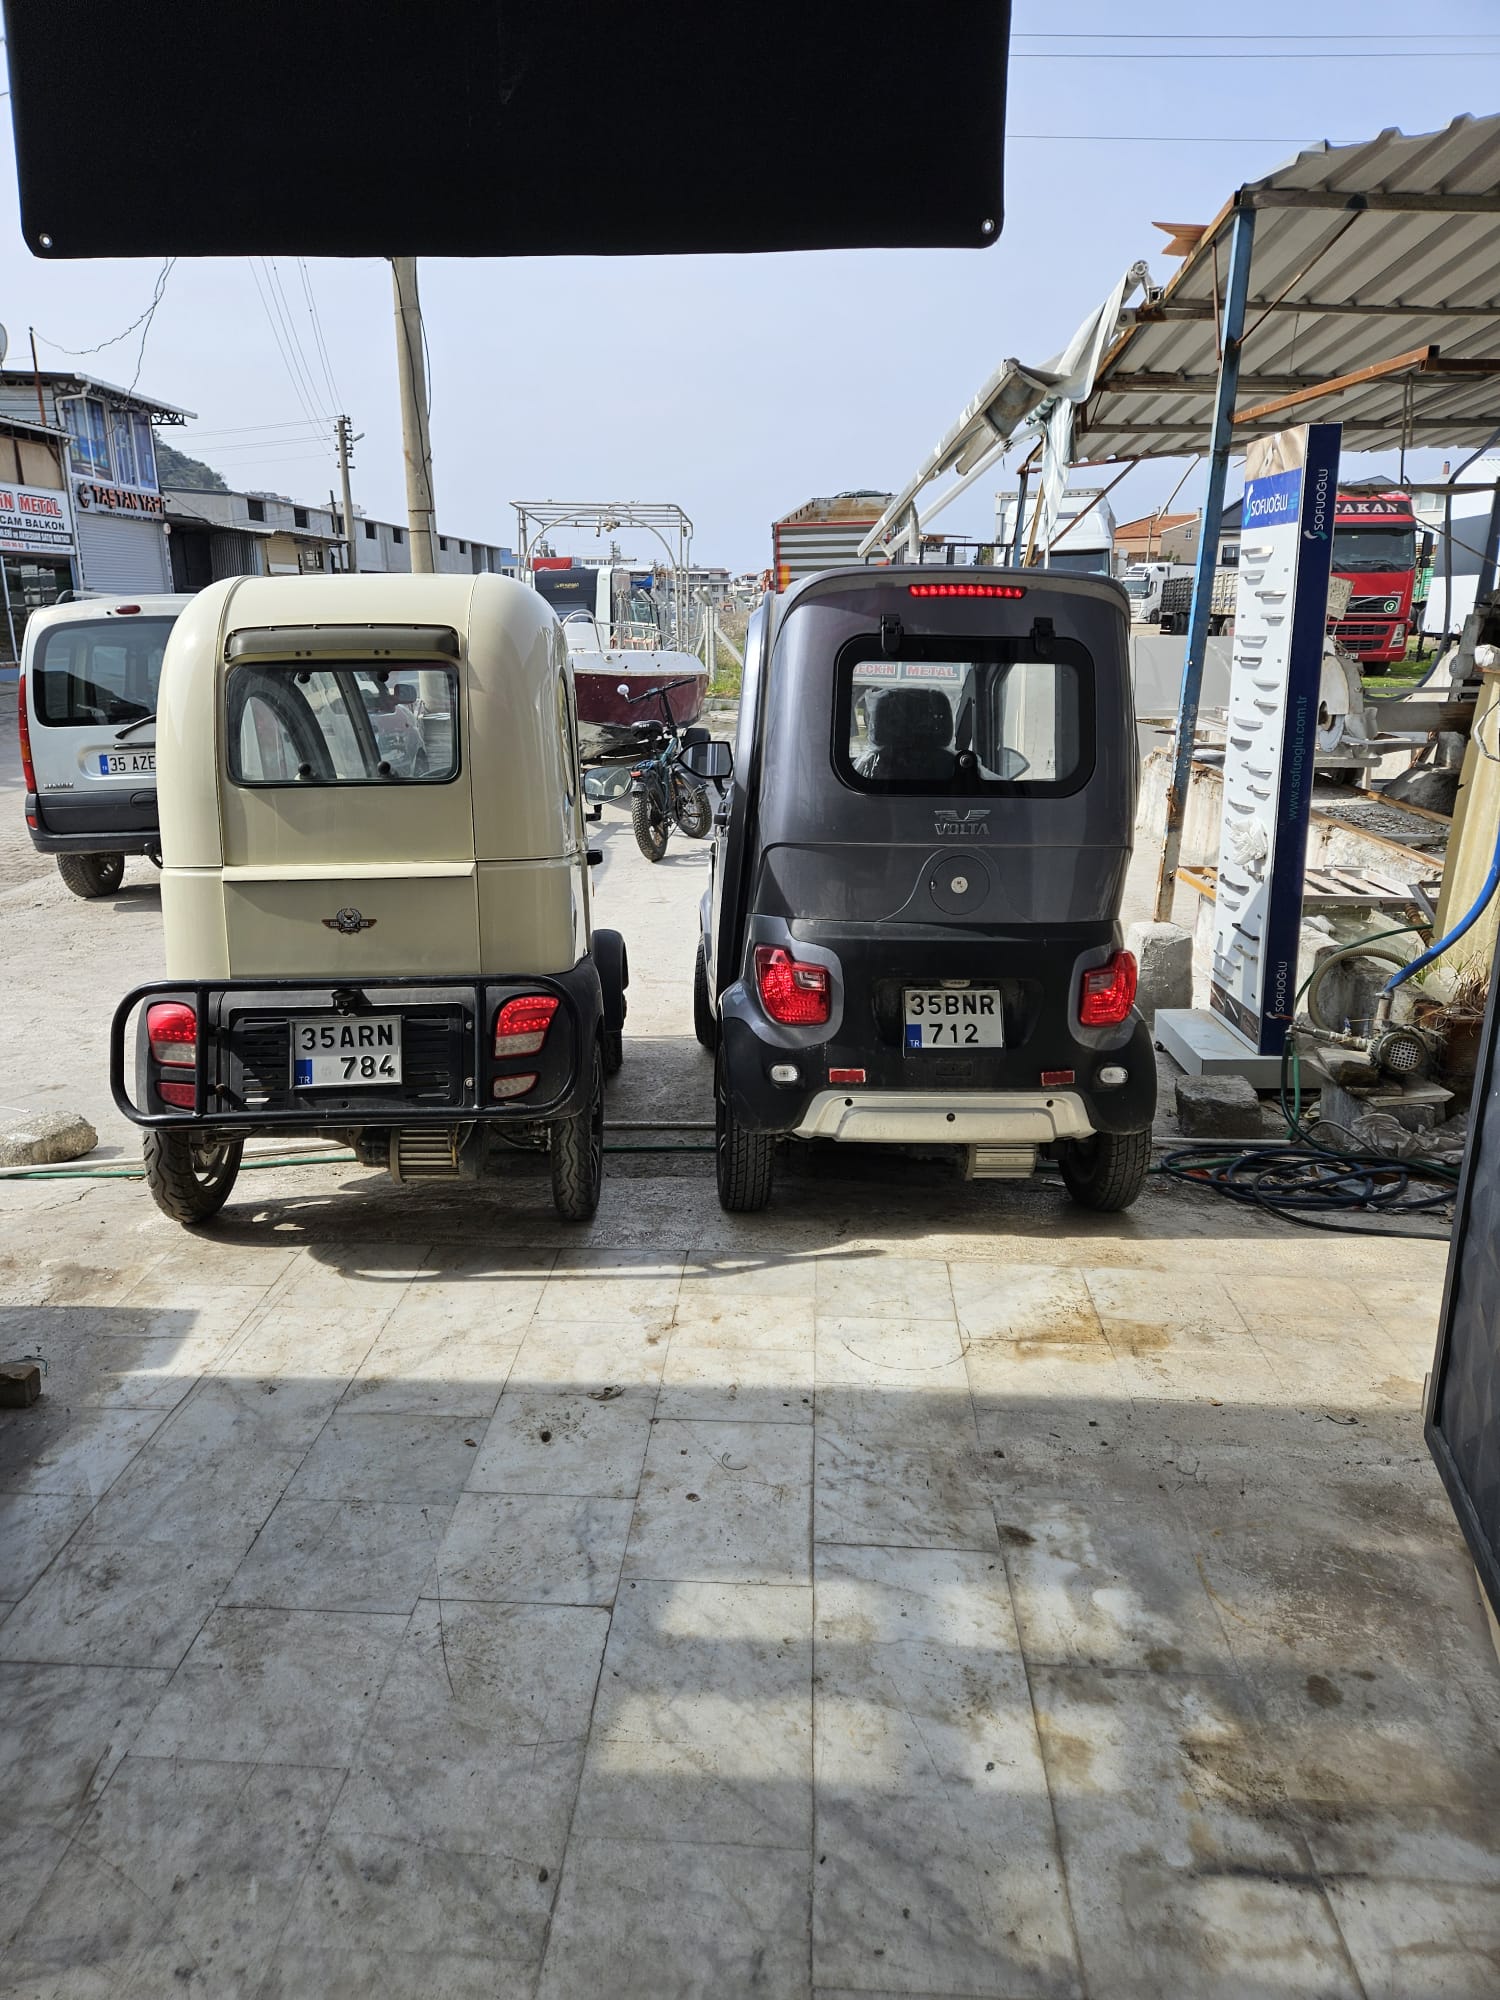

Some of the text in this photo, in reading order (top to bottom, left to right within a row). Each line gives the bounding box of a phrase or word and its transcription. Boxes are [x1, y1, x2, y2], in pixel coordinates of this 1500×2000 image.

[19, 494, 62, 516] METAL
[1250, 493, 1289, 517] SOFUOĞLU
[1314, 468, 1329, 531] SOFUOĞLU
[25, 518, 65, 531] BALKON
[907, 665, 958, 677] METAL
[109, 757, 126, 772] 35
[1288, 696, 1308, 821] www.sofuoglu.com.tr
[934, 823, 991, 835] VOLTA
[929, 1023, 979, 1044] 712
[340, 1054, 395, 1080] 784
[299, 1076, 311, 1084] TR
